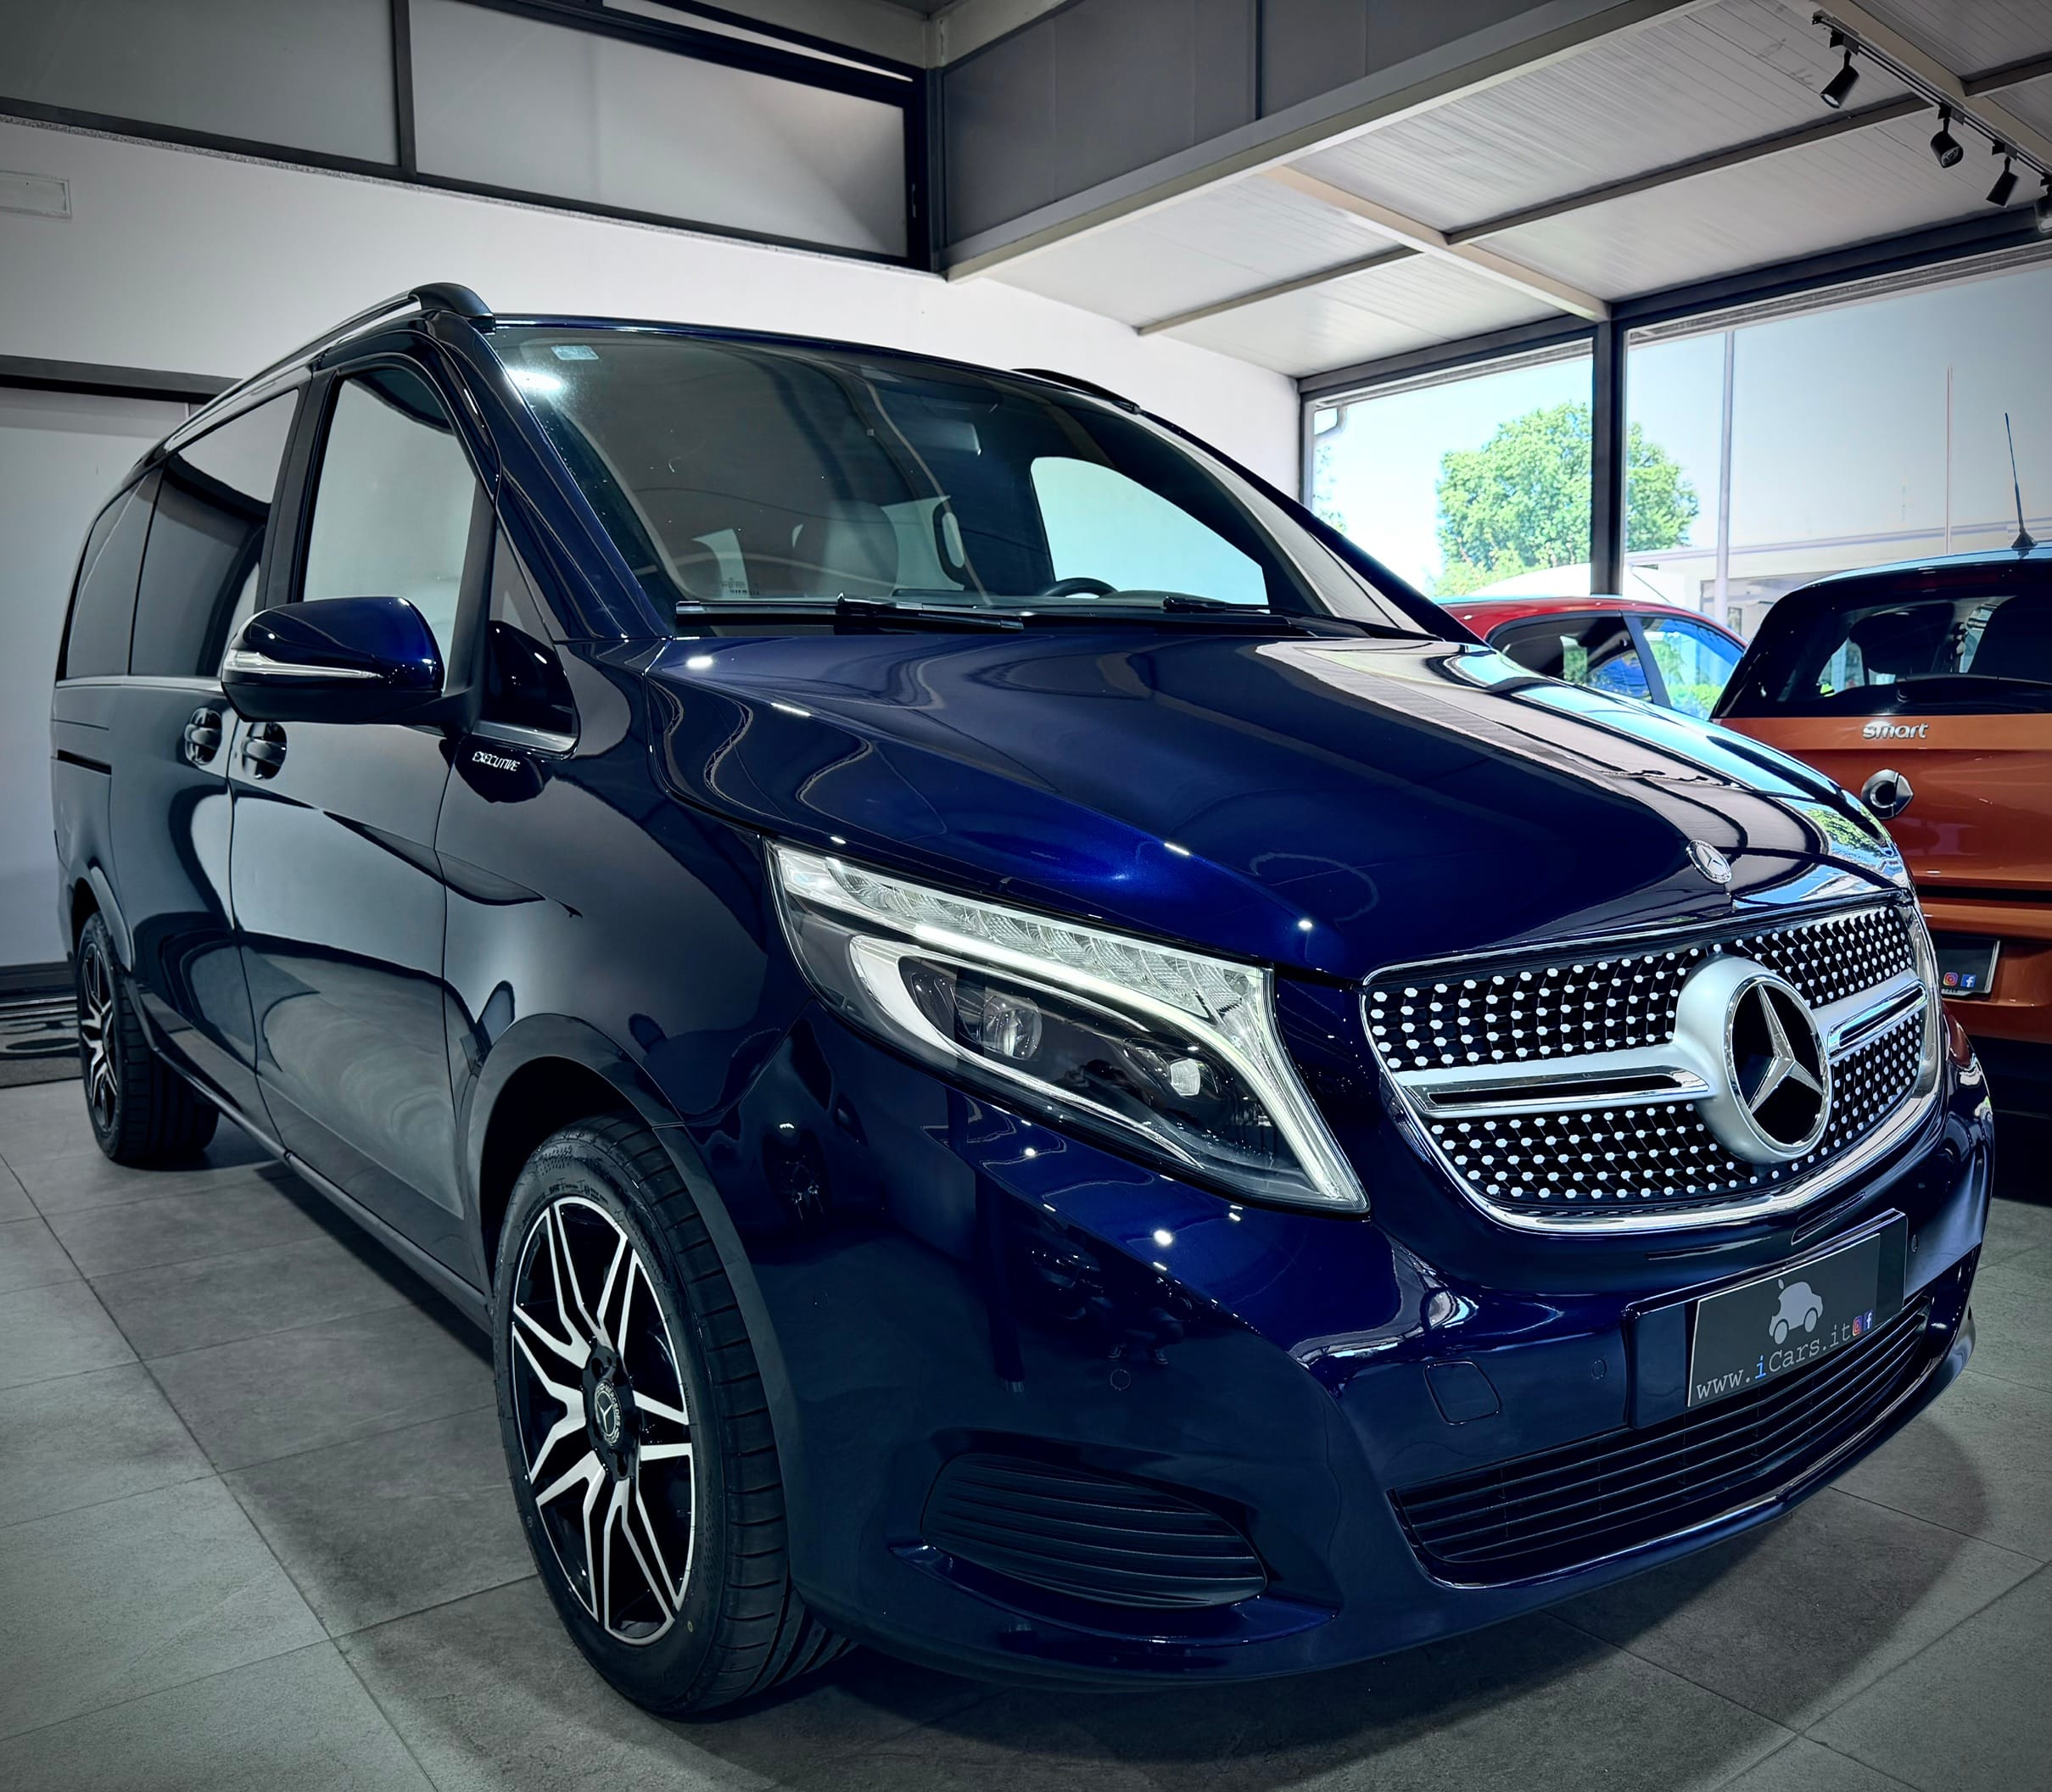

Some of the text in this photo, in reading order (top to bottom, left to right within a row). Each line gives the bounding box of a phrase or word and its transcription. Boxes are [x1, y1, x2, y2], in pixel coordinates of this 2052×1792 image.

[1862, 721, 1928, 740] smart
[472, 751, 521, 772] EXECUTIVE
[1696, 1323, 1851, 1400] www.iCars.it
